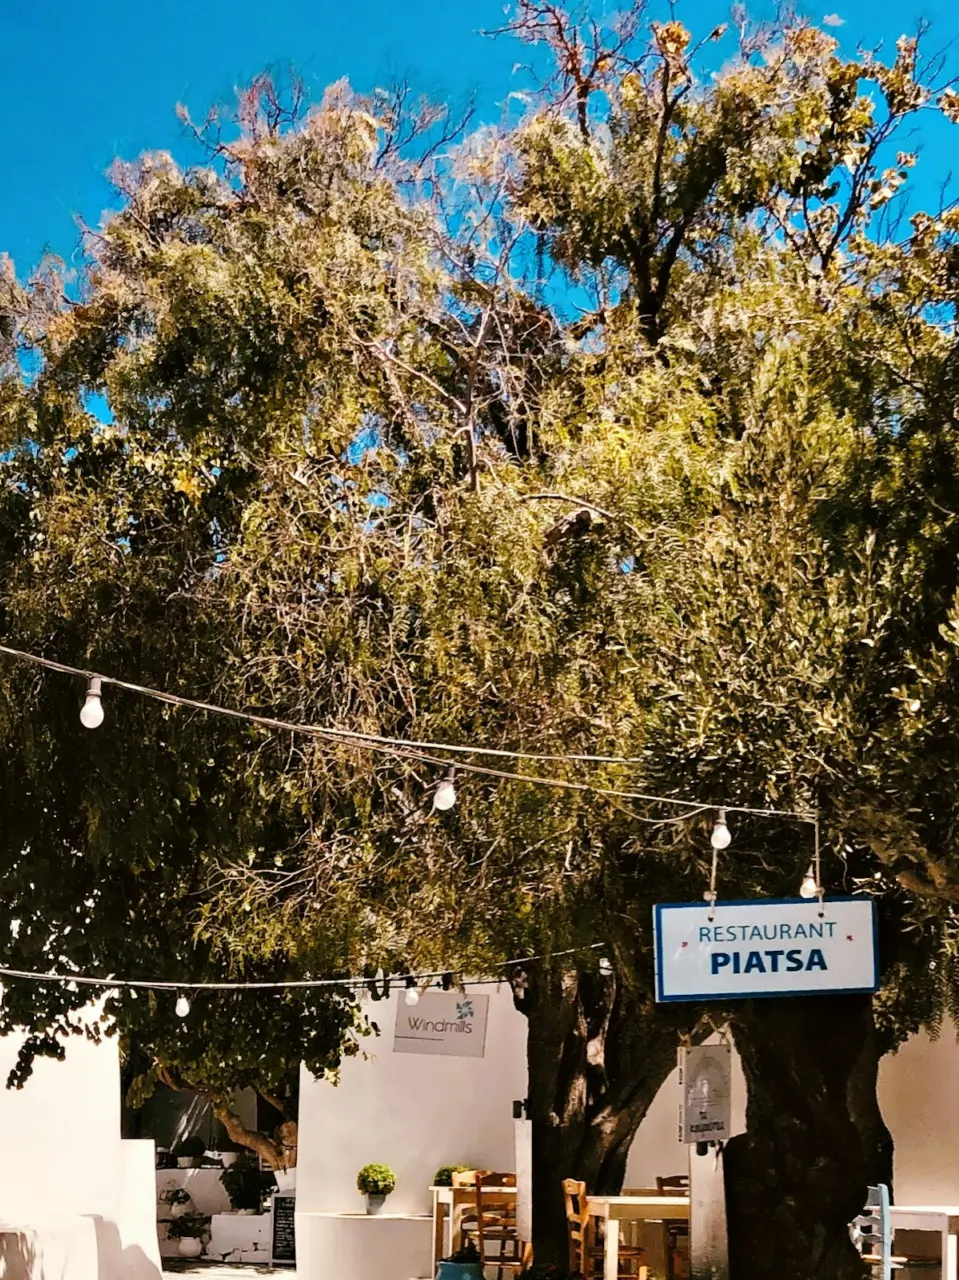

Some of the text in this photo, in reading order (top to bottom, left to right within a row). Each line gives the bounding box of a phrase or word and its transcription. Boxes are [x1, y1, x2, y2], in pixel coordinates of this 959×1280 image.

[698, 922, 838, 942] RESTAURANT
[710, 949, 828, 975] PIATSA
[408, 1017, 473, 1034] Windmills
